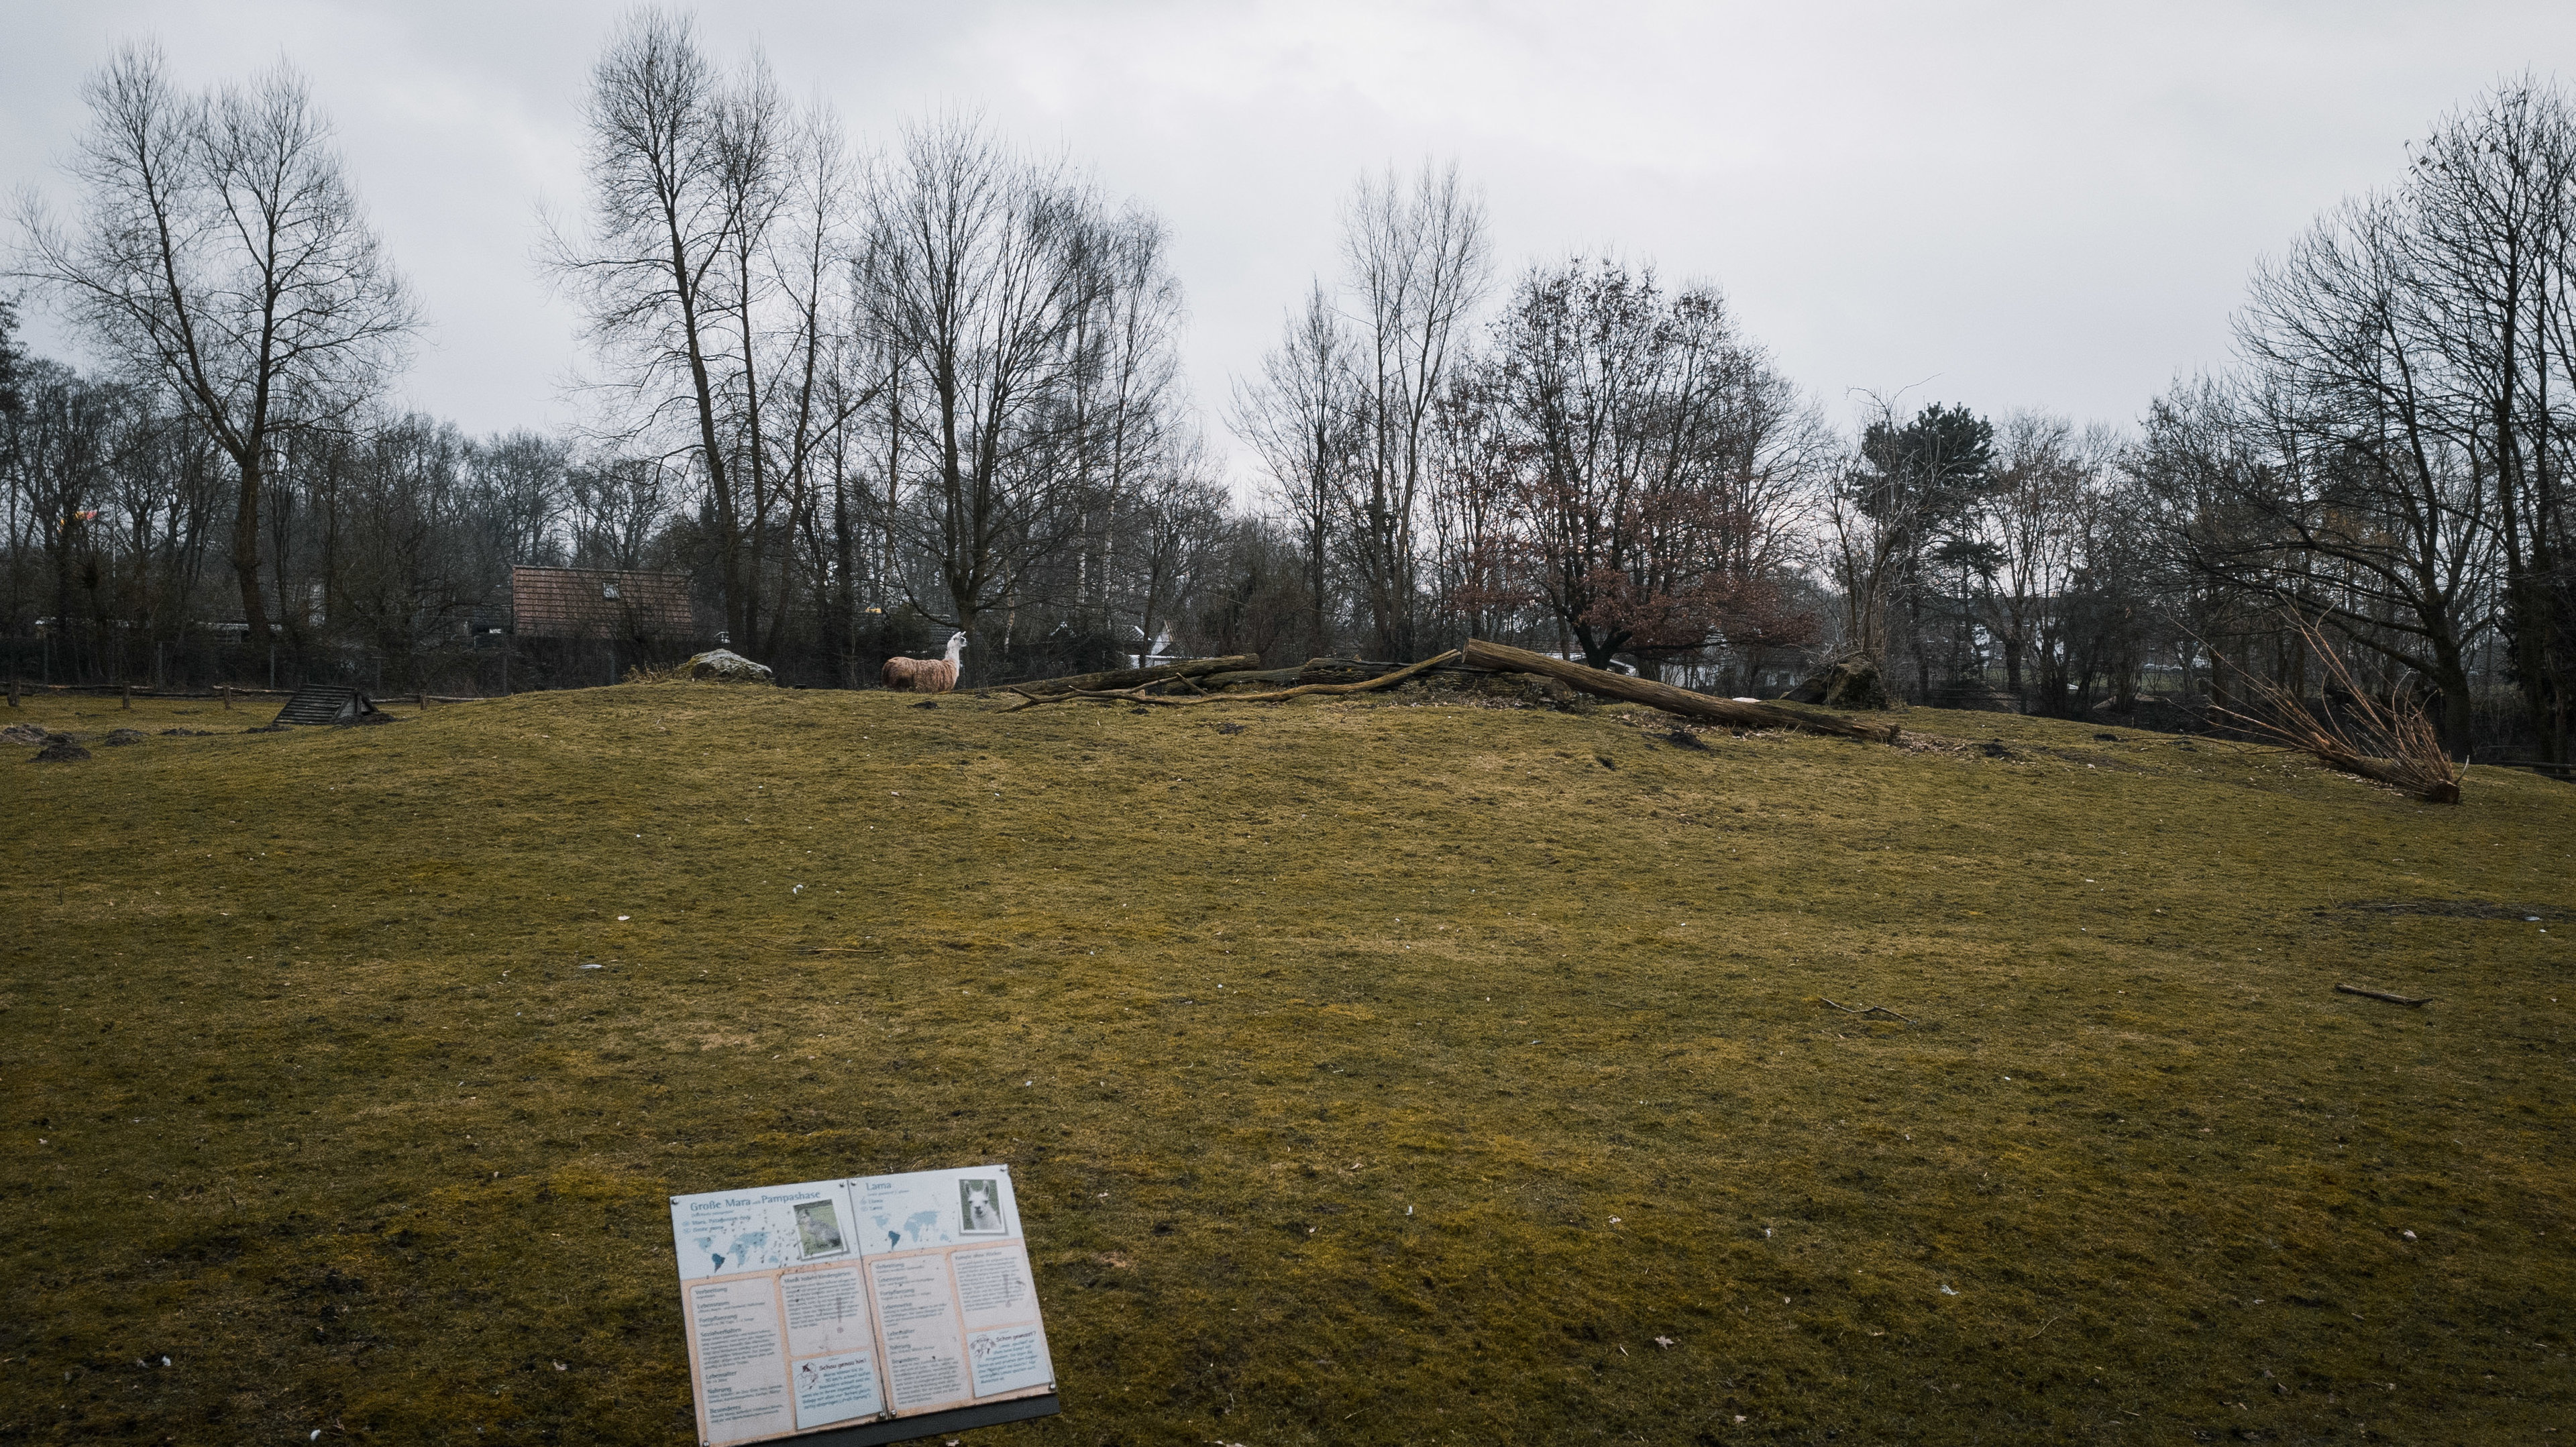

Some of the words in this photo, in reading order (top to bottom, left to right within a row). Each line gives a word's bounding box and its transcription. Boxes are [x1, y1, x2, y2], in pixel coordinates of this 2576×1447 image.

[866, 1182, 892, 1191] Lama
[690, 1201, 721, 1212] Große
[725, 1198, 751, 1208] Mara
[761, 1190, 821, 1205] Pampashase
[698, 1315, 737, 1323] Fortpflanzung
[700, 1328, 742, 1337] Sozialverhalten
[838, 1361, 855, 1369] genau
[855, 1357, 867, 1365] hin!
